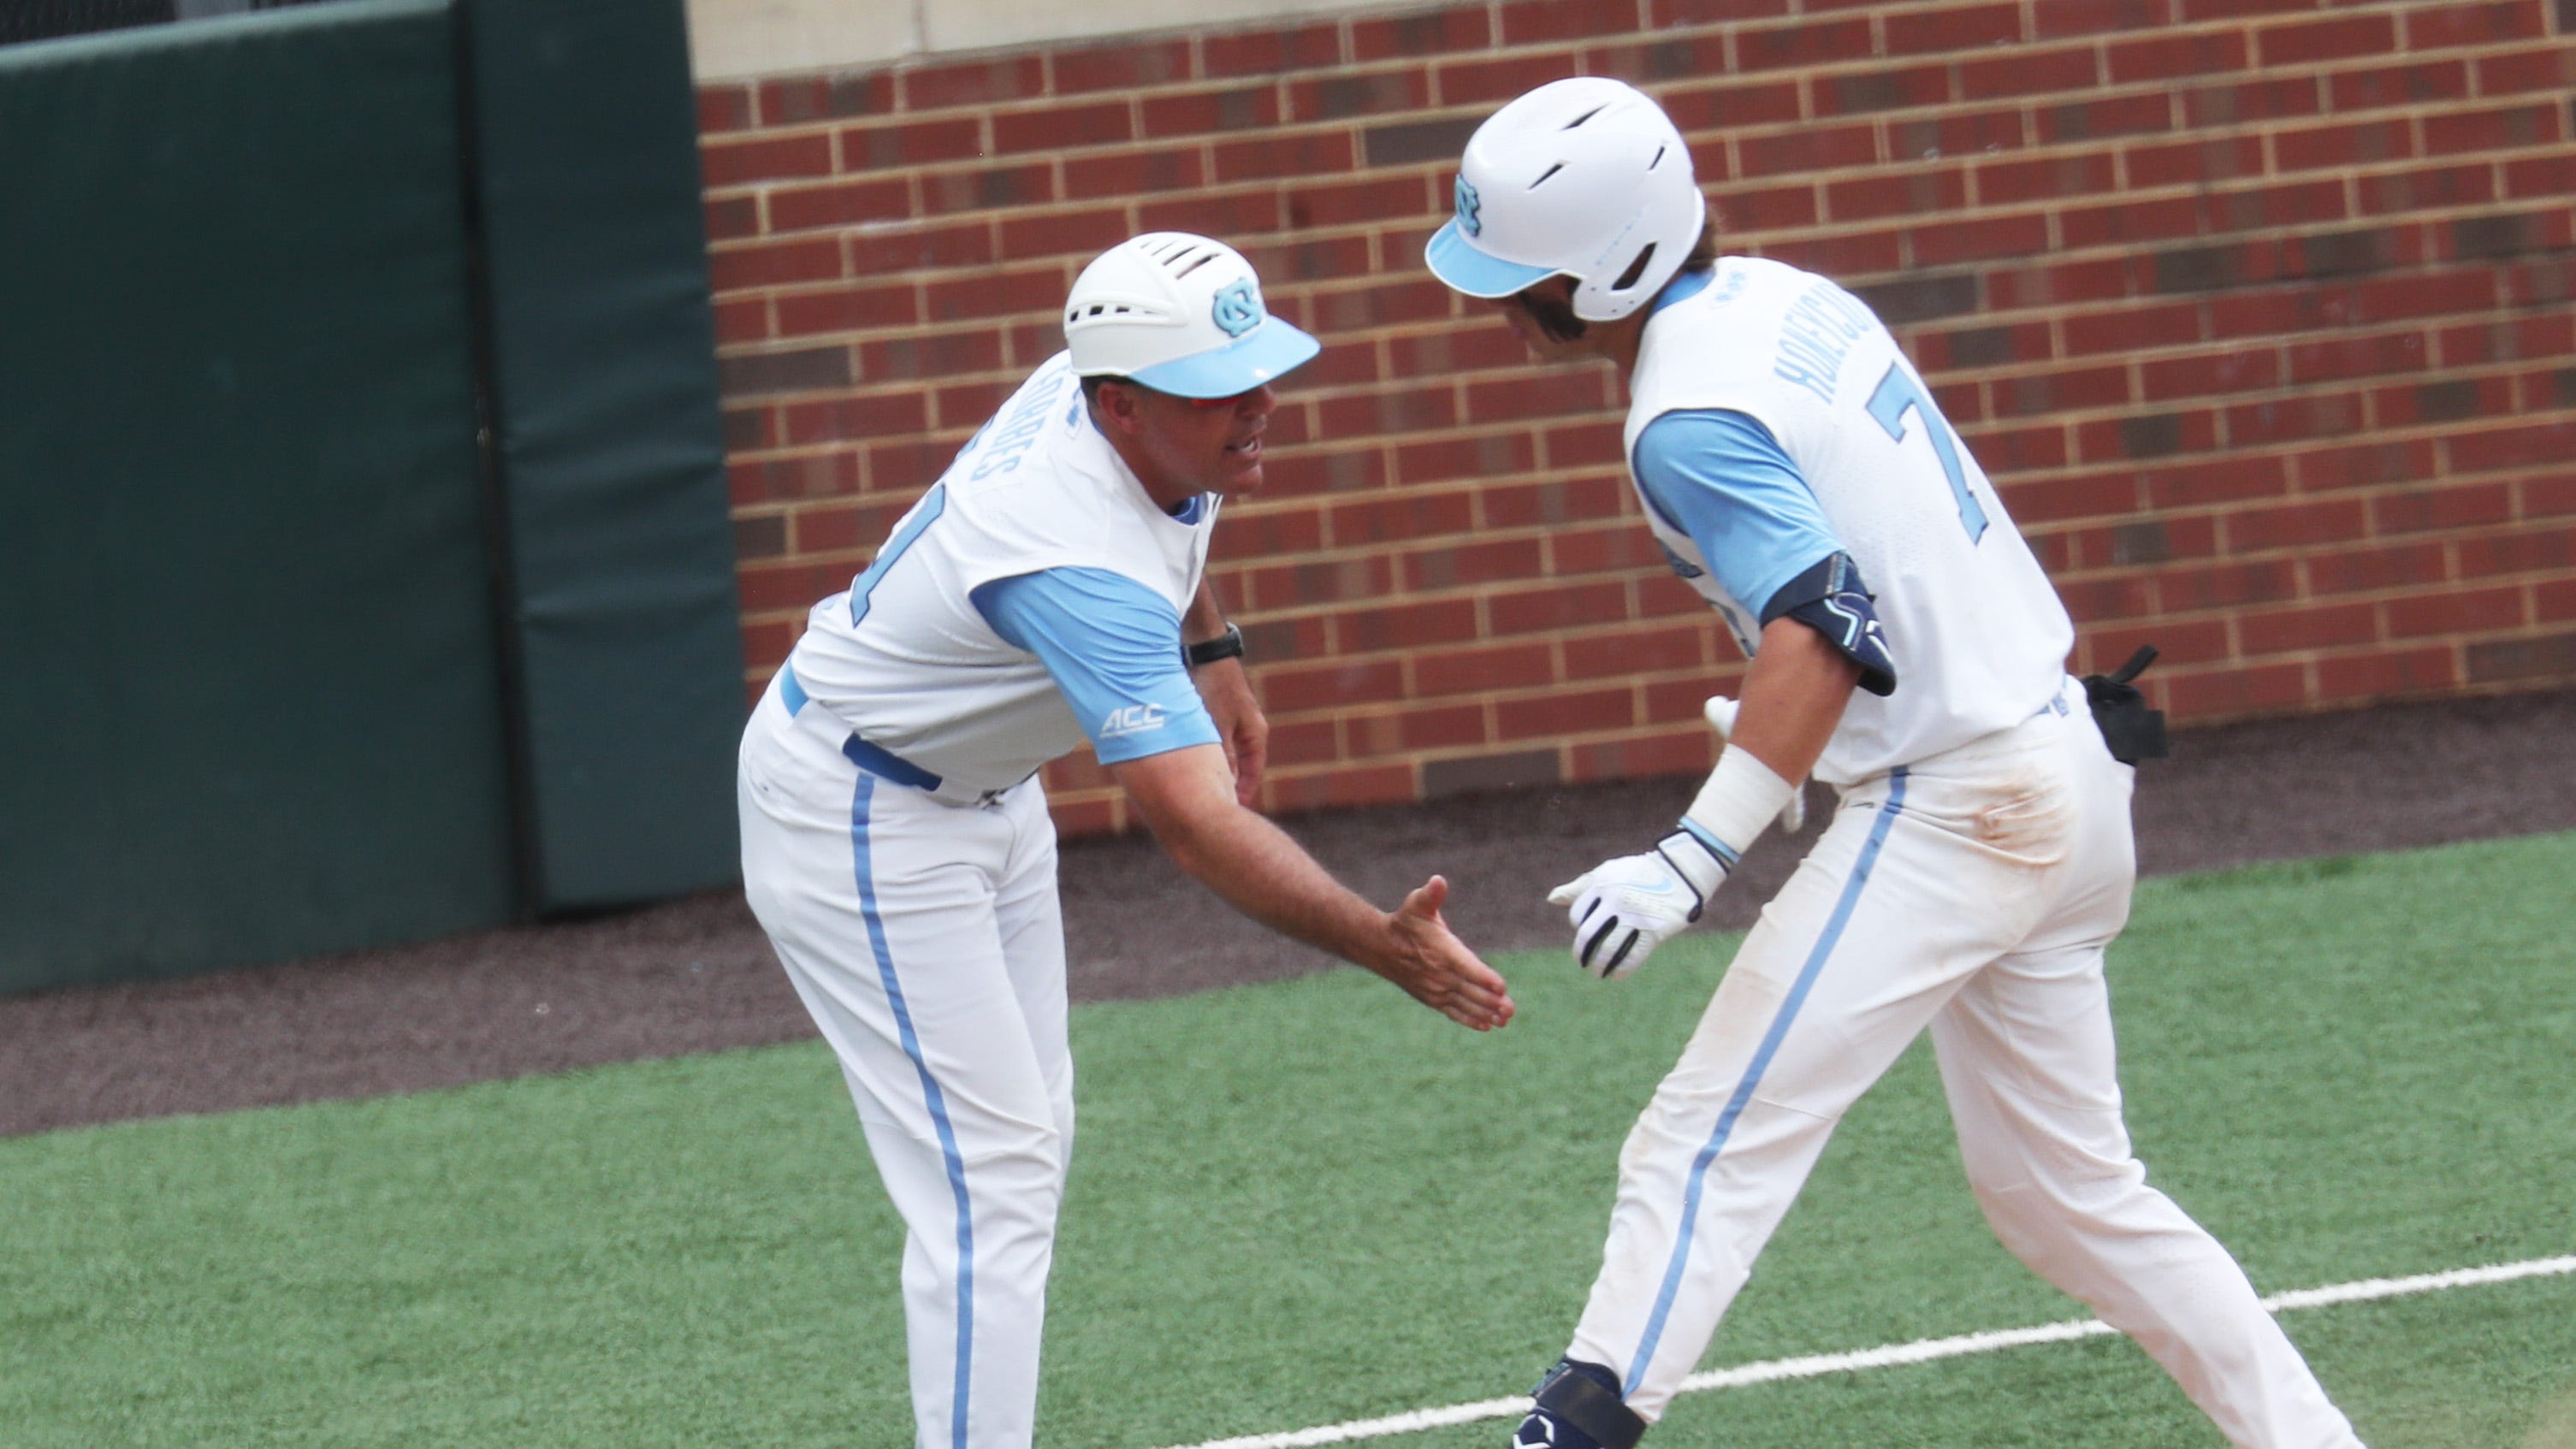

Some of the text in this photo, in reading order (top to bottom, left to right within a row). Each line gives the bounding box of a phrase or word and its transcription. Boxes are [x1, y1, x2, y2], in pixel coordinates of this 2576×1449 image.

[969, 364, 1070, 482] FORBES
[1864, 359, 1990, 547] 7
[1100, 703, 1164, 736] ACC
